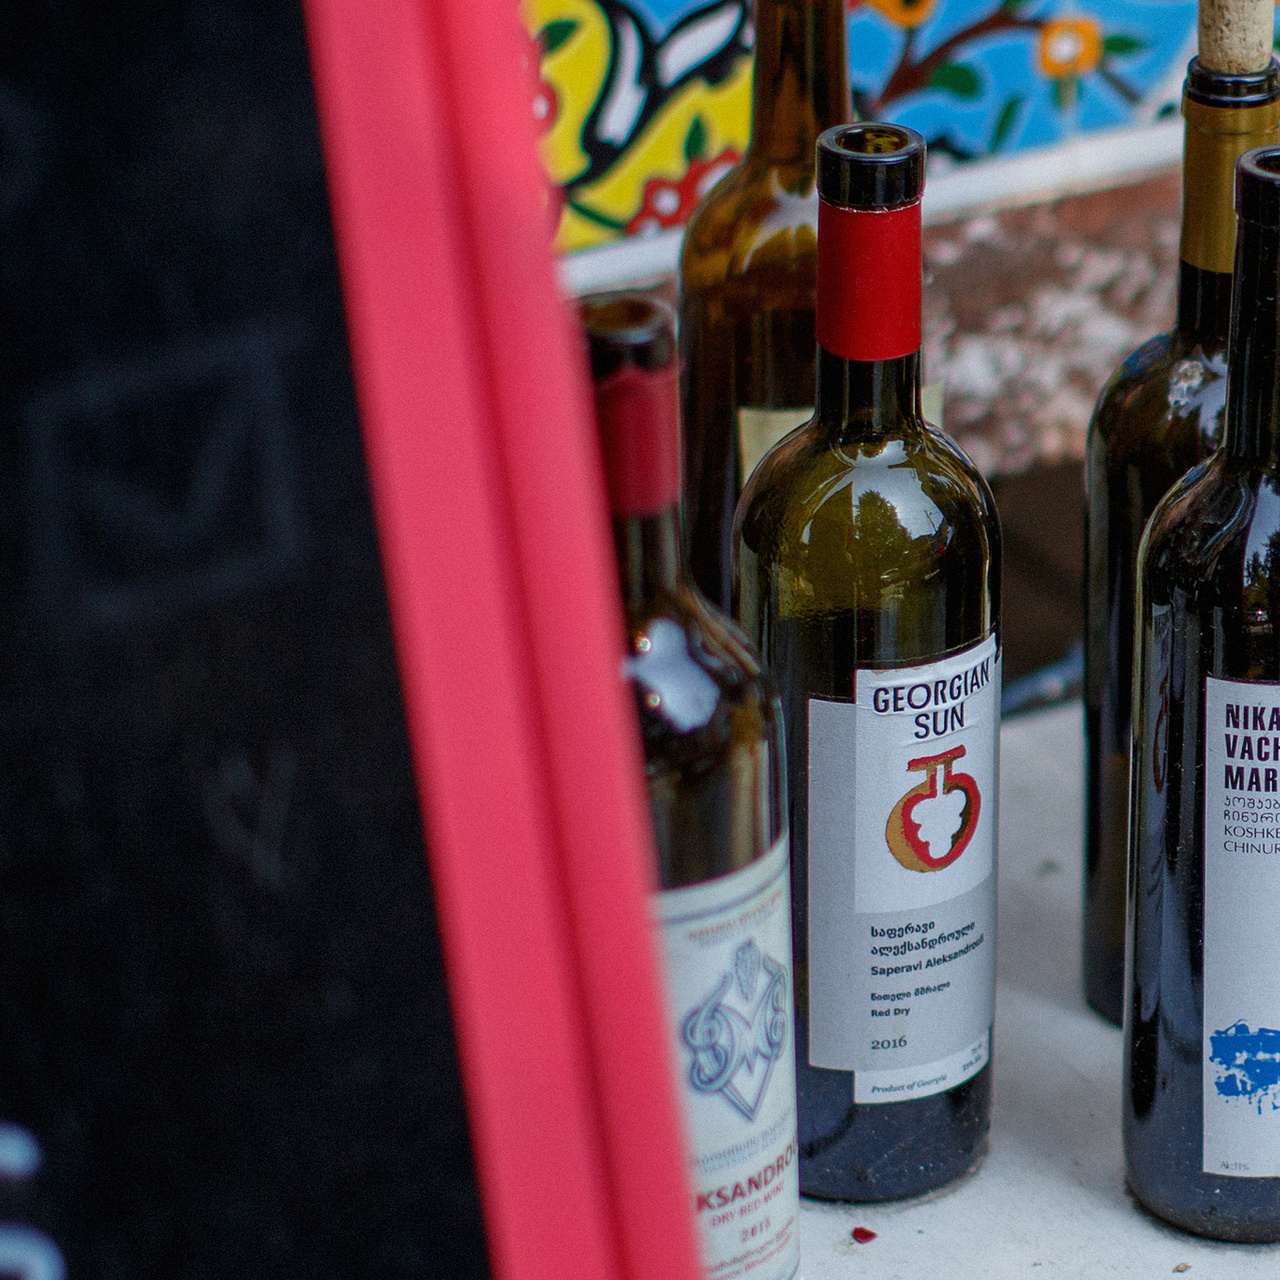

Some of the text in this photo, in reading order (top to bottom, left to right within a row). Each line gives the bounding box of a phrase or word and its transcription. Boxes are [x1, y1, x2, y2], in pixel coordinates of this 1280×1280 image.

[872, 657, 990, 713] GEORGIAN
[914, 701, 965, 739] SUN
[871, 921, 935, 939] საფერავი
[871, 921, 975, 956] ალექსანდროული
[871, 961, 922, 976] Saperavi
[871, 1007, 911, 1017] Red Dry
[871, 1035, 907, 1050] 2016
[871, 1084, 905, 1094] Product
[712, 1211, 735, 1227] DRY
[739, 1199, 761, 1217] RED
